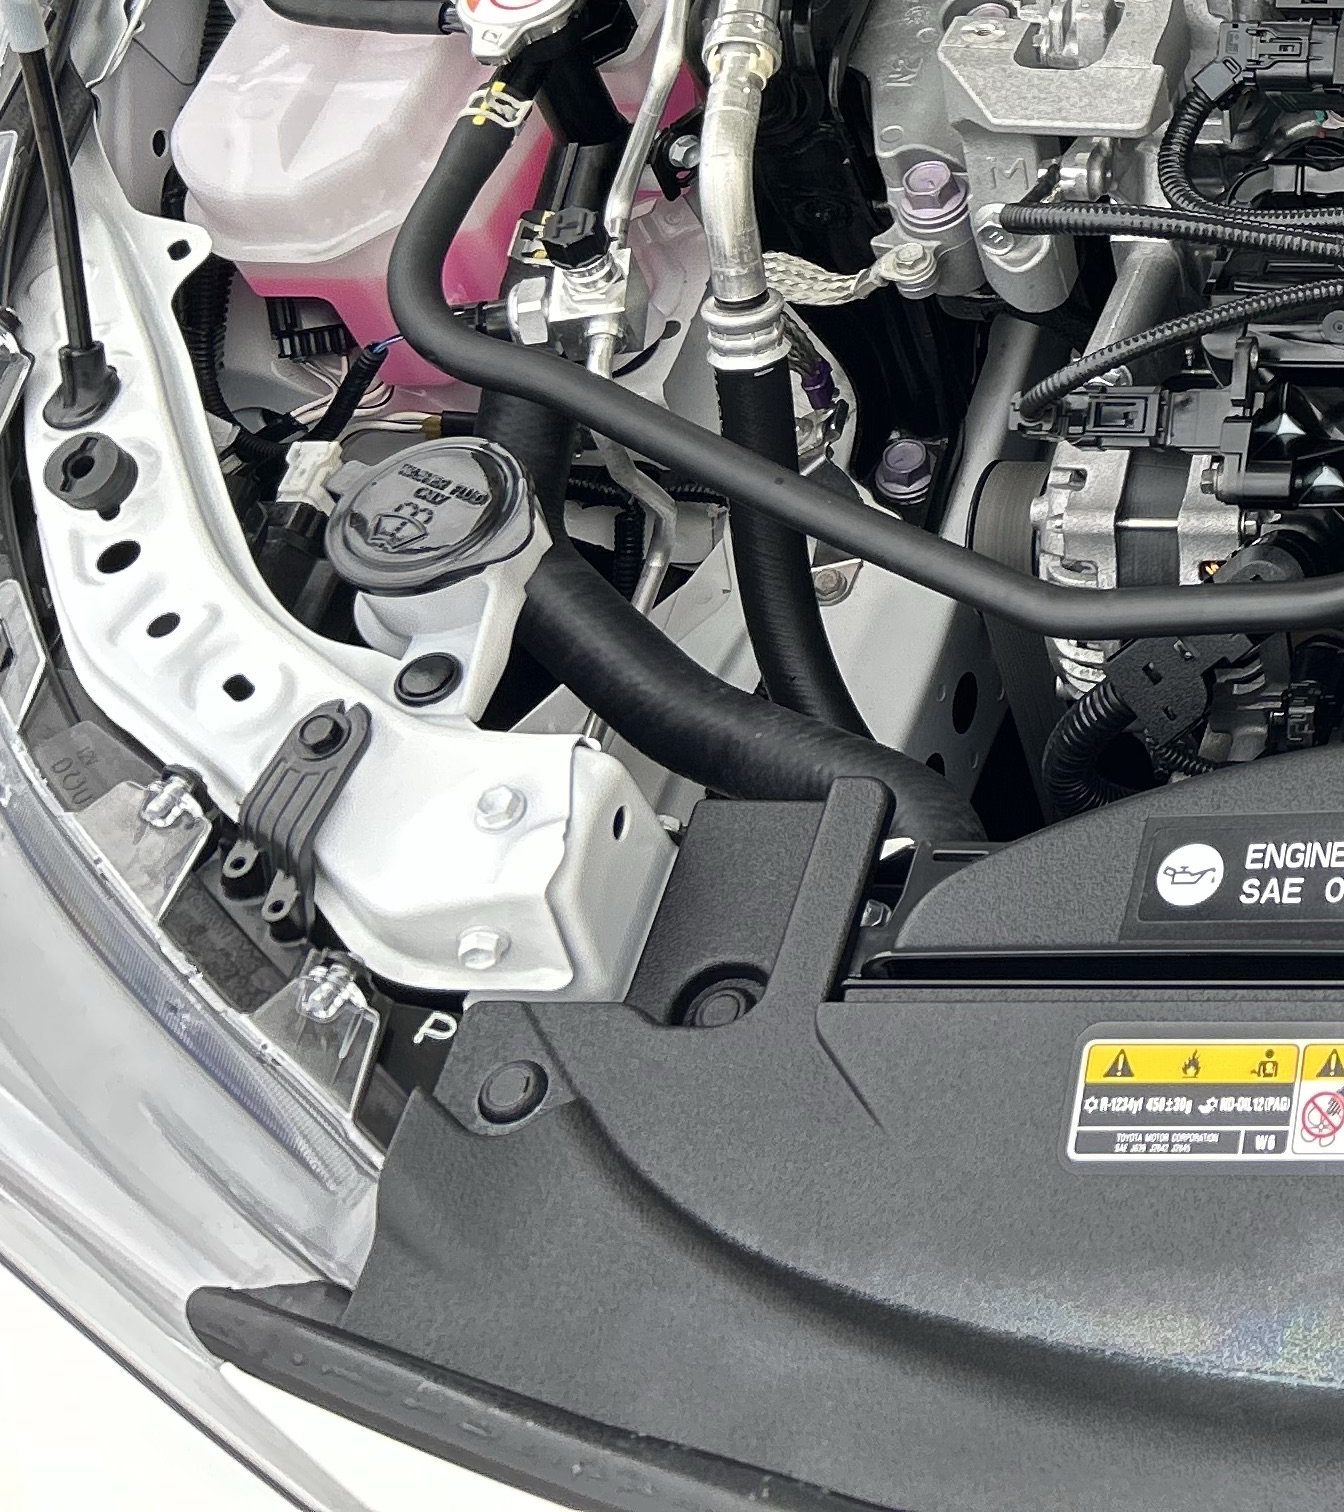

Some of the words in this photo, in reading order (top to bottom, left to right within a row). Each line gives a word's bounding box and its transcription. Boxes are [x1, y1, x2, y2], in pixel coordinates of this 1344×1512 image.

[1239, 877, 1304, 904] SAE
[413, 1011, 458, 1044] P
[1116, 1132, 1142, 1143] TOYOTA
[1145, 1132, 1169, 1143] MOTOR
[1171, 1132, 1220, 1143] CORPORATION
[1114, 1143, 1128, 1153] SAE
